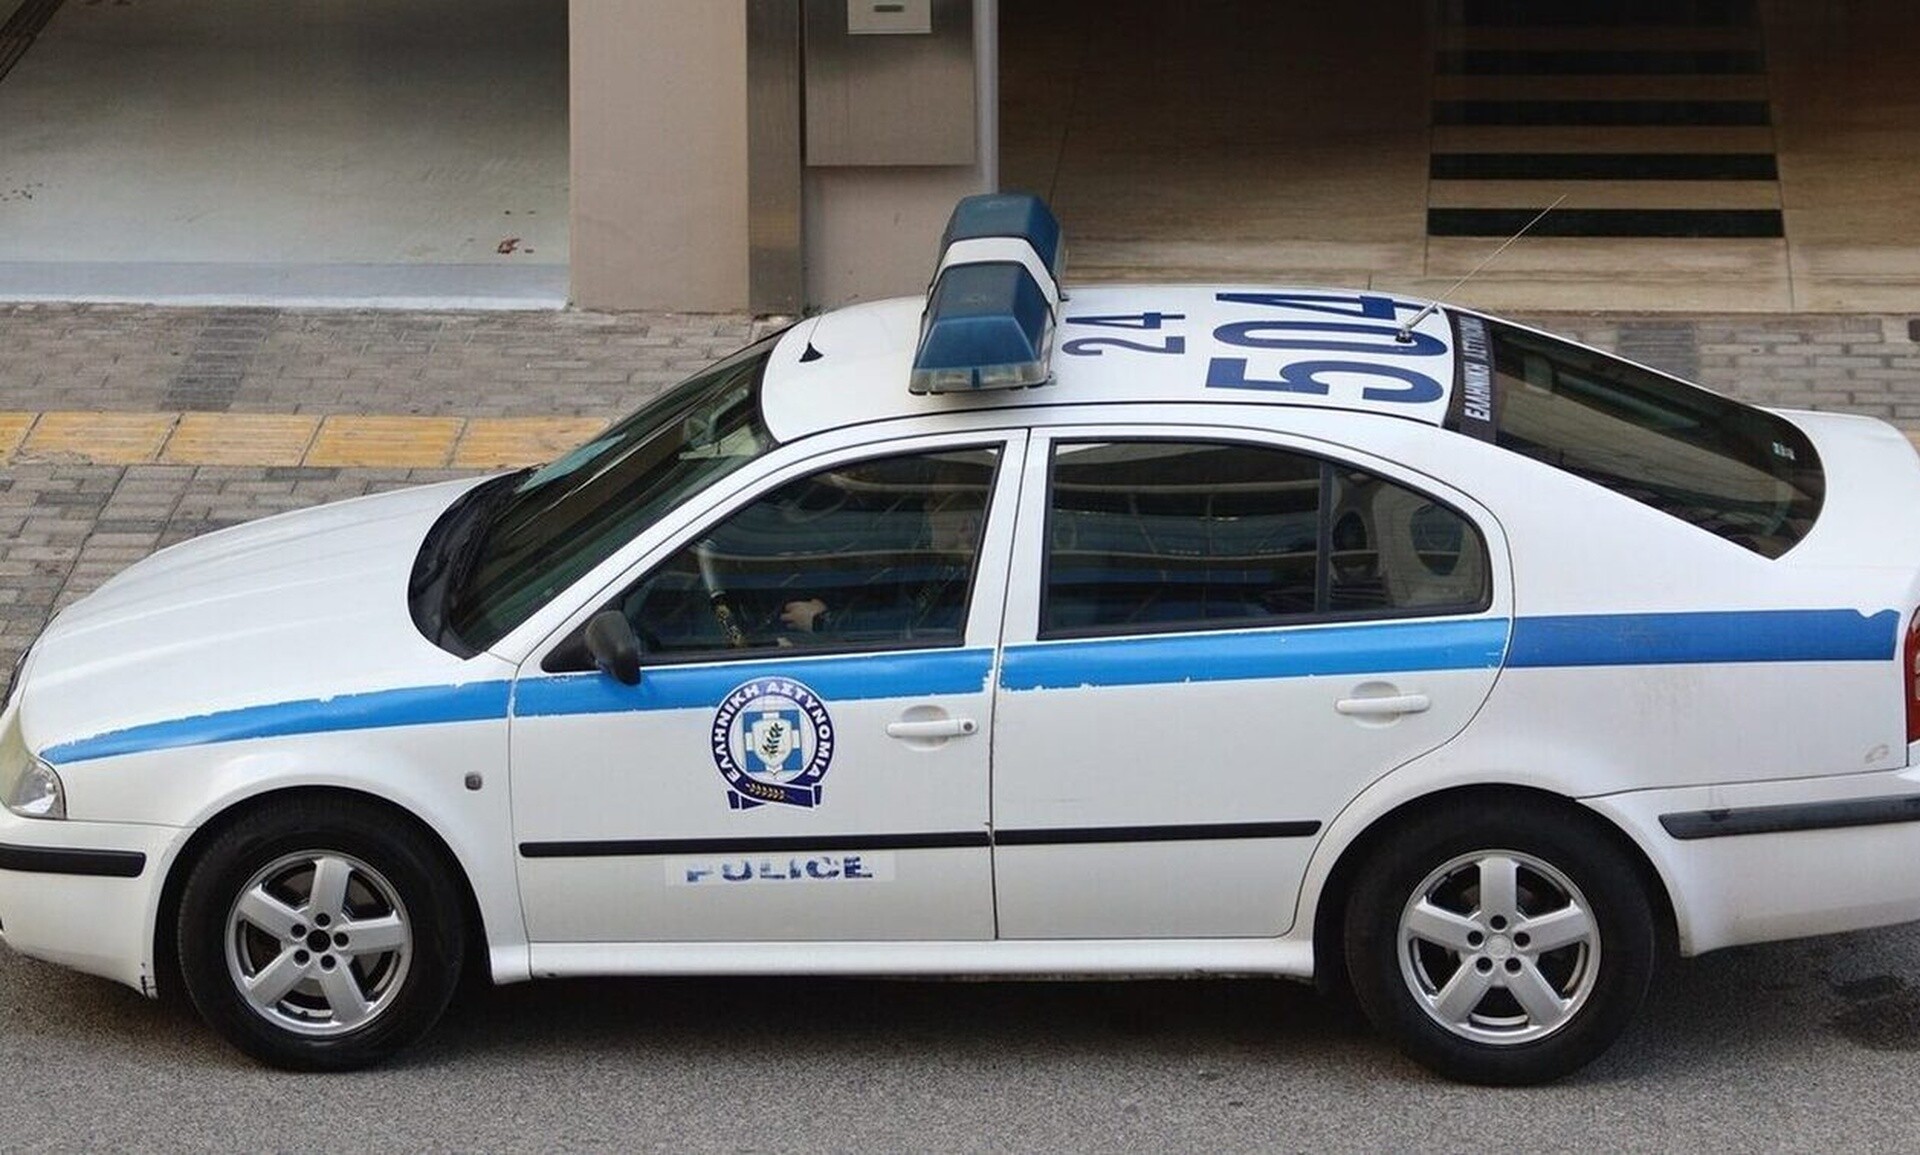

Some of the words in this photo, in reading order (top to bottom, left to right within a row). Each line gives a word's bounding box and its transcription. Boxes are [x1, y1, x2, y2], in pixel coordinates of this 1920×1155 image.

[1061, 312, 1186, 356] 24
[1205, 292, 1448, 404] 504
[714, 684, 761, 783] ΕΛΛΗΝΙΚΗ
[766, 681, 833, 778] ΑΣΤΥΝΟΜΙΑ
